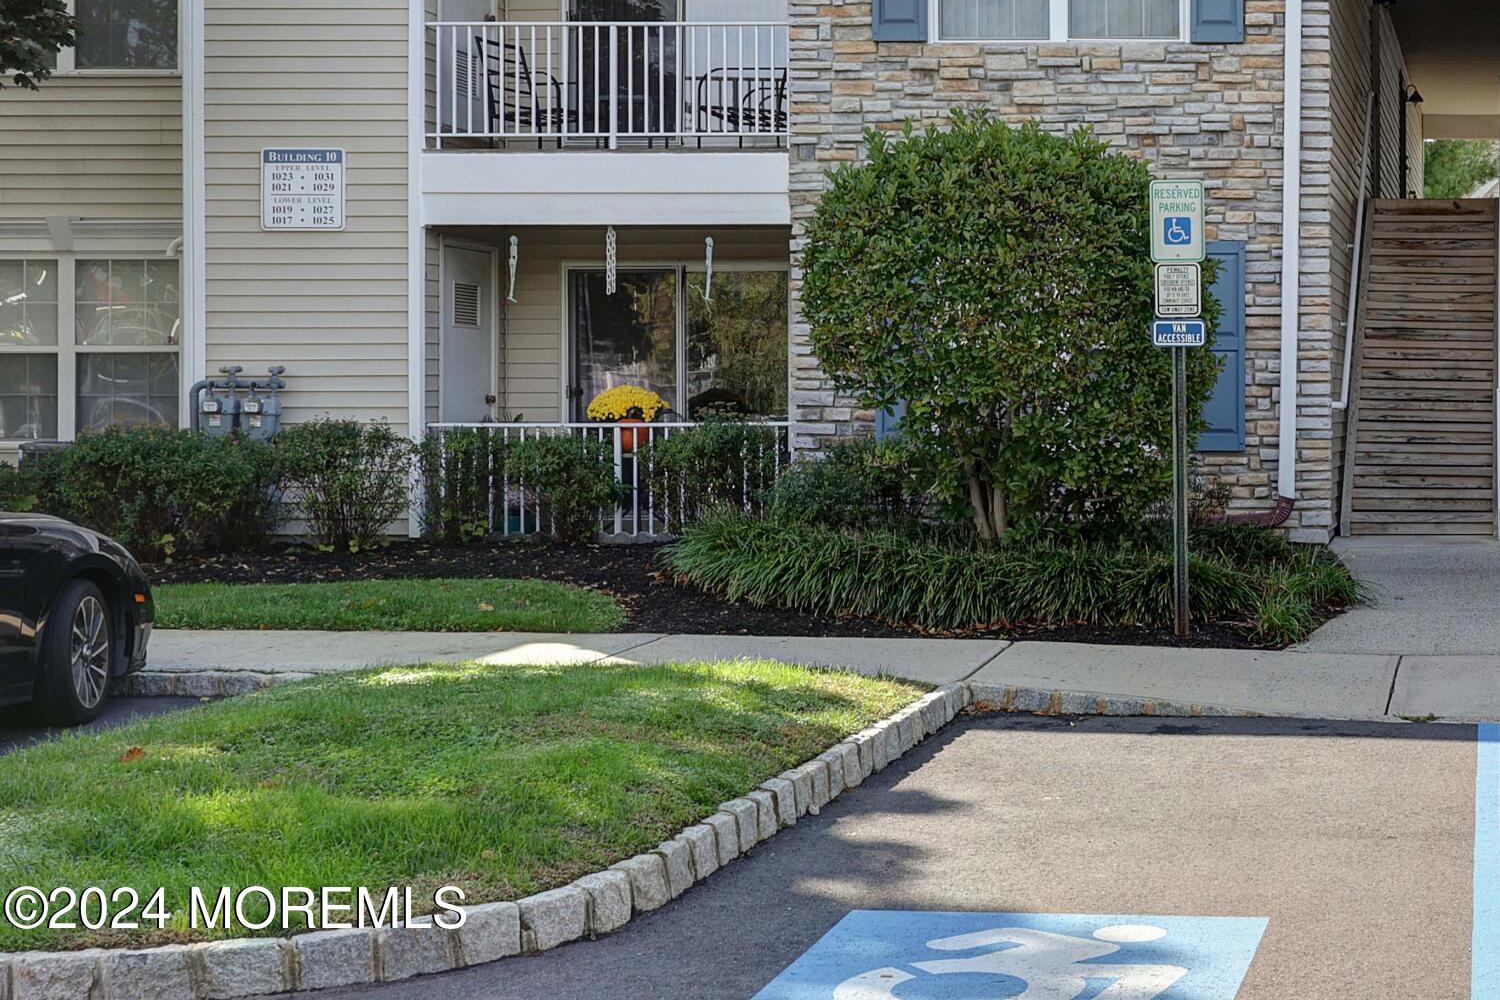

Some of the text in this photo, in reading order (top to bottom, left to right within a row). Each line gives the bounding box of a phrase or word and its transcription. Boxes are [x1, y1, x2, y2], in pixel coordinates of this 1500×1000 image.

[326, 151, 337, 162] 10
[272, 173, 334, 181] 1023 1031
[272, 183, 335, 191] 1021 1029
[1153, 188, 1200, 199] RESERVED
[272, 206, 334, 214] 1019 1027
[1158, 202, 1196, 213] PARKING
[272, 216, 335, 225] 1017 1025
[1172, 323, 1187, 333] VAN
[1157, 333, 1201, 343] ACCESSIBLE
